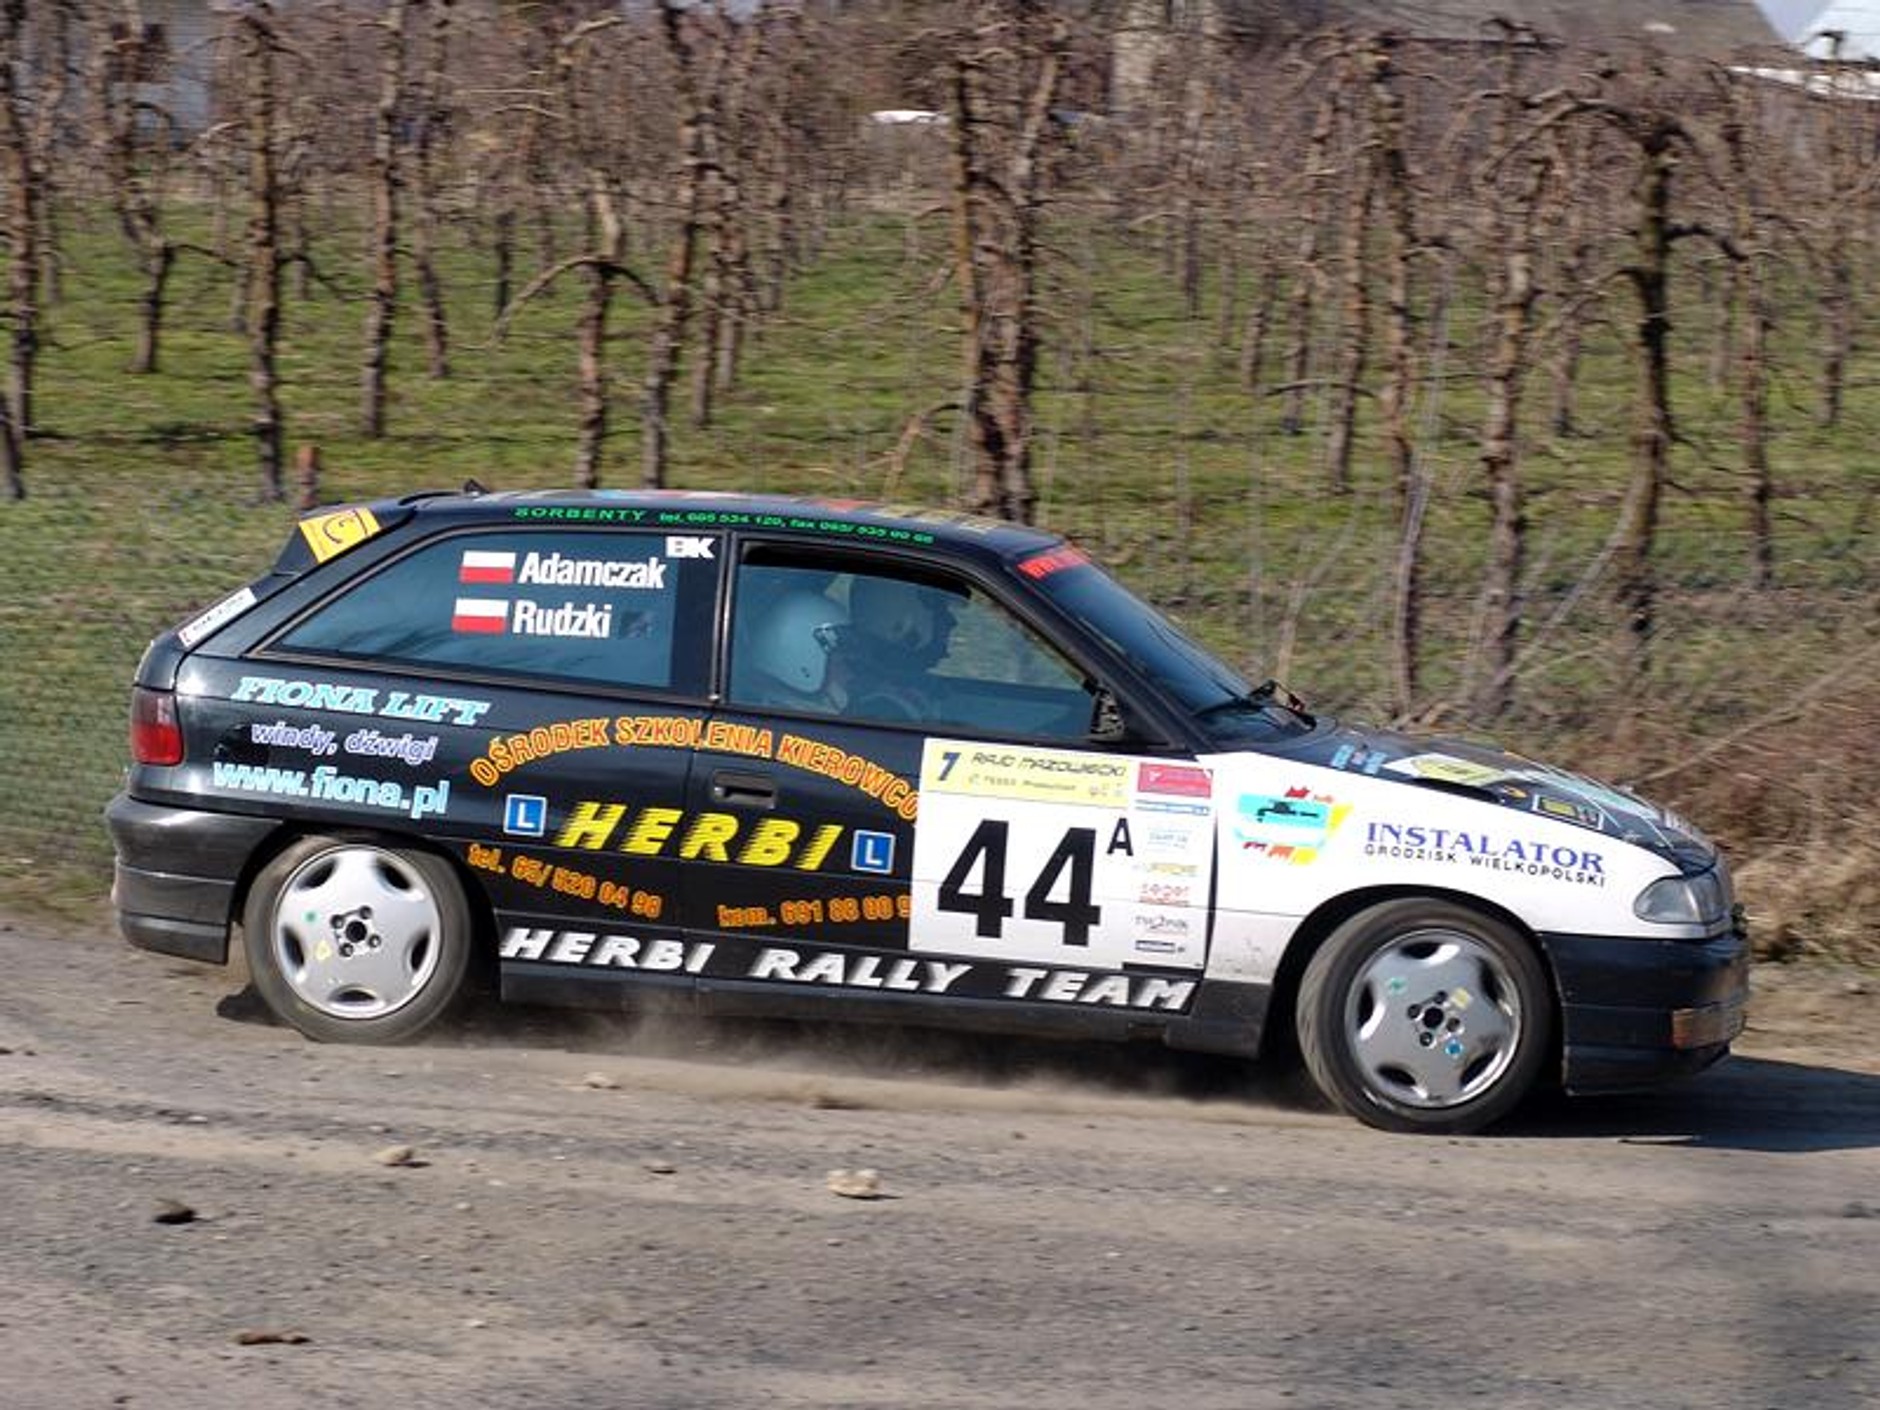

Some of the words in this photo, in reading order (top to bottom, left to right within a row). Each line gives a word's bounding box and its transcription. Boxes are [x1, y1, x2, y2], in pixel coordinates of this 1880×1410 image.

[514, 507, 647, 521] SORBENTY
[517, 551, 666, 589] Adamczak
[665, 535, 715, 558] BK
[512, 600, 612, 638] Rudzki
[230, 676, 379, 714] FIONA
[379, 692, 492, 726] LIFT
[251, 721, 337, 754] windy,
[345, 729, 438, 764] dźwigi
[470, 716, 611, 786] OŚRODEK
[615, 716, 773, 758] SZKOLENIA
[212, 761, 450, 819] www.fiona.pl
[938, 752, 961, 781] 7
[552, 800, 844, 871] HERBI
[1366, 822, 1606, 874] INSTALATOR
[937, 819, 1101, 947] 44
[1106, 817, 1134, 857] A
[1364, 843, 1457, 863] GRODZISK
[1469, 854, 1606, 888] WIELKOPOLSKI
[499, 927, 716, 973] HERBI
[750, 949, 973, 993] RALLY
[1001, 967, 1198, 1010] TEAM
